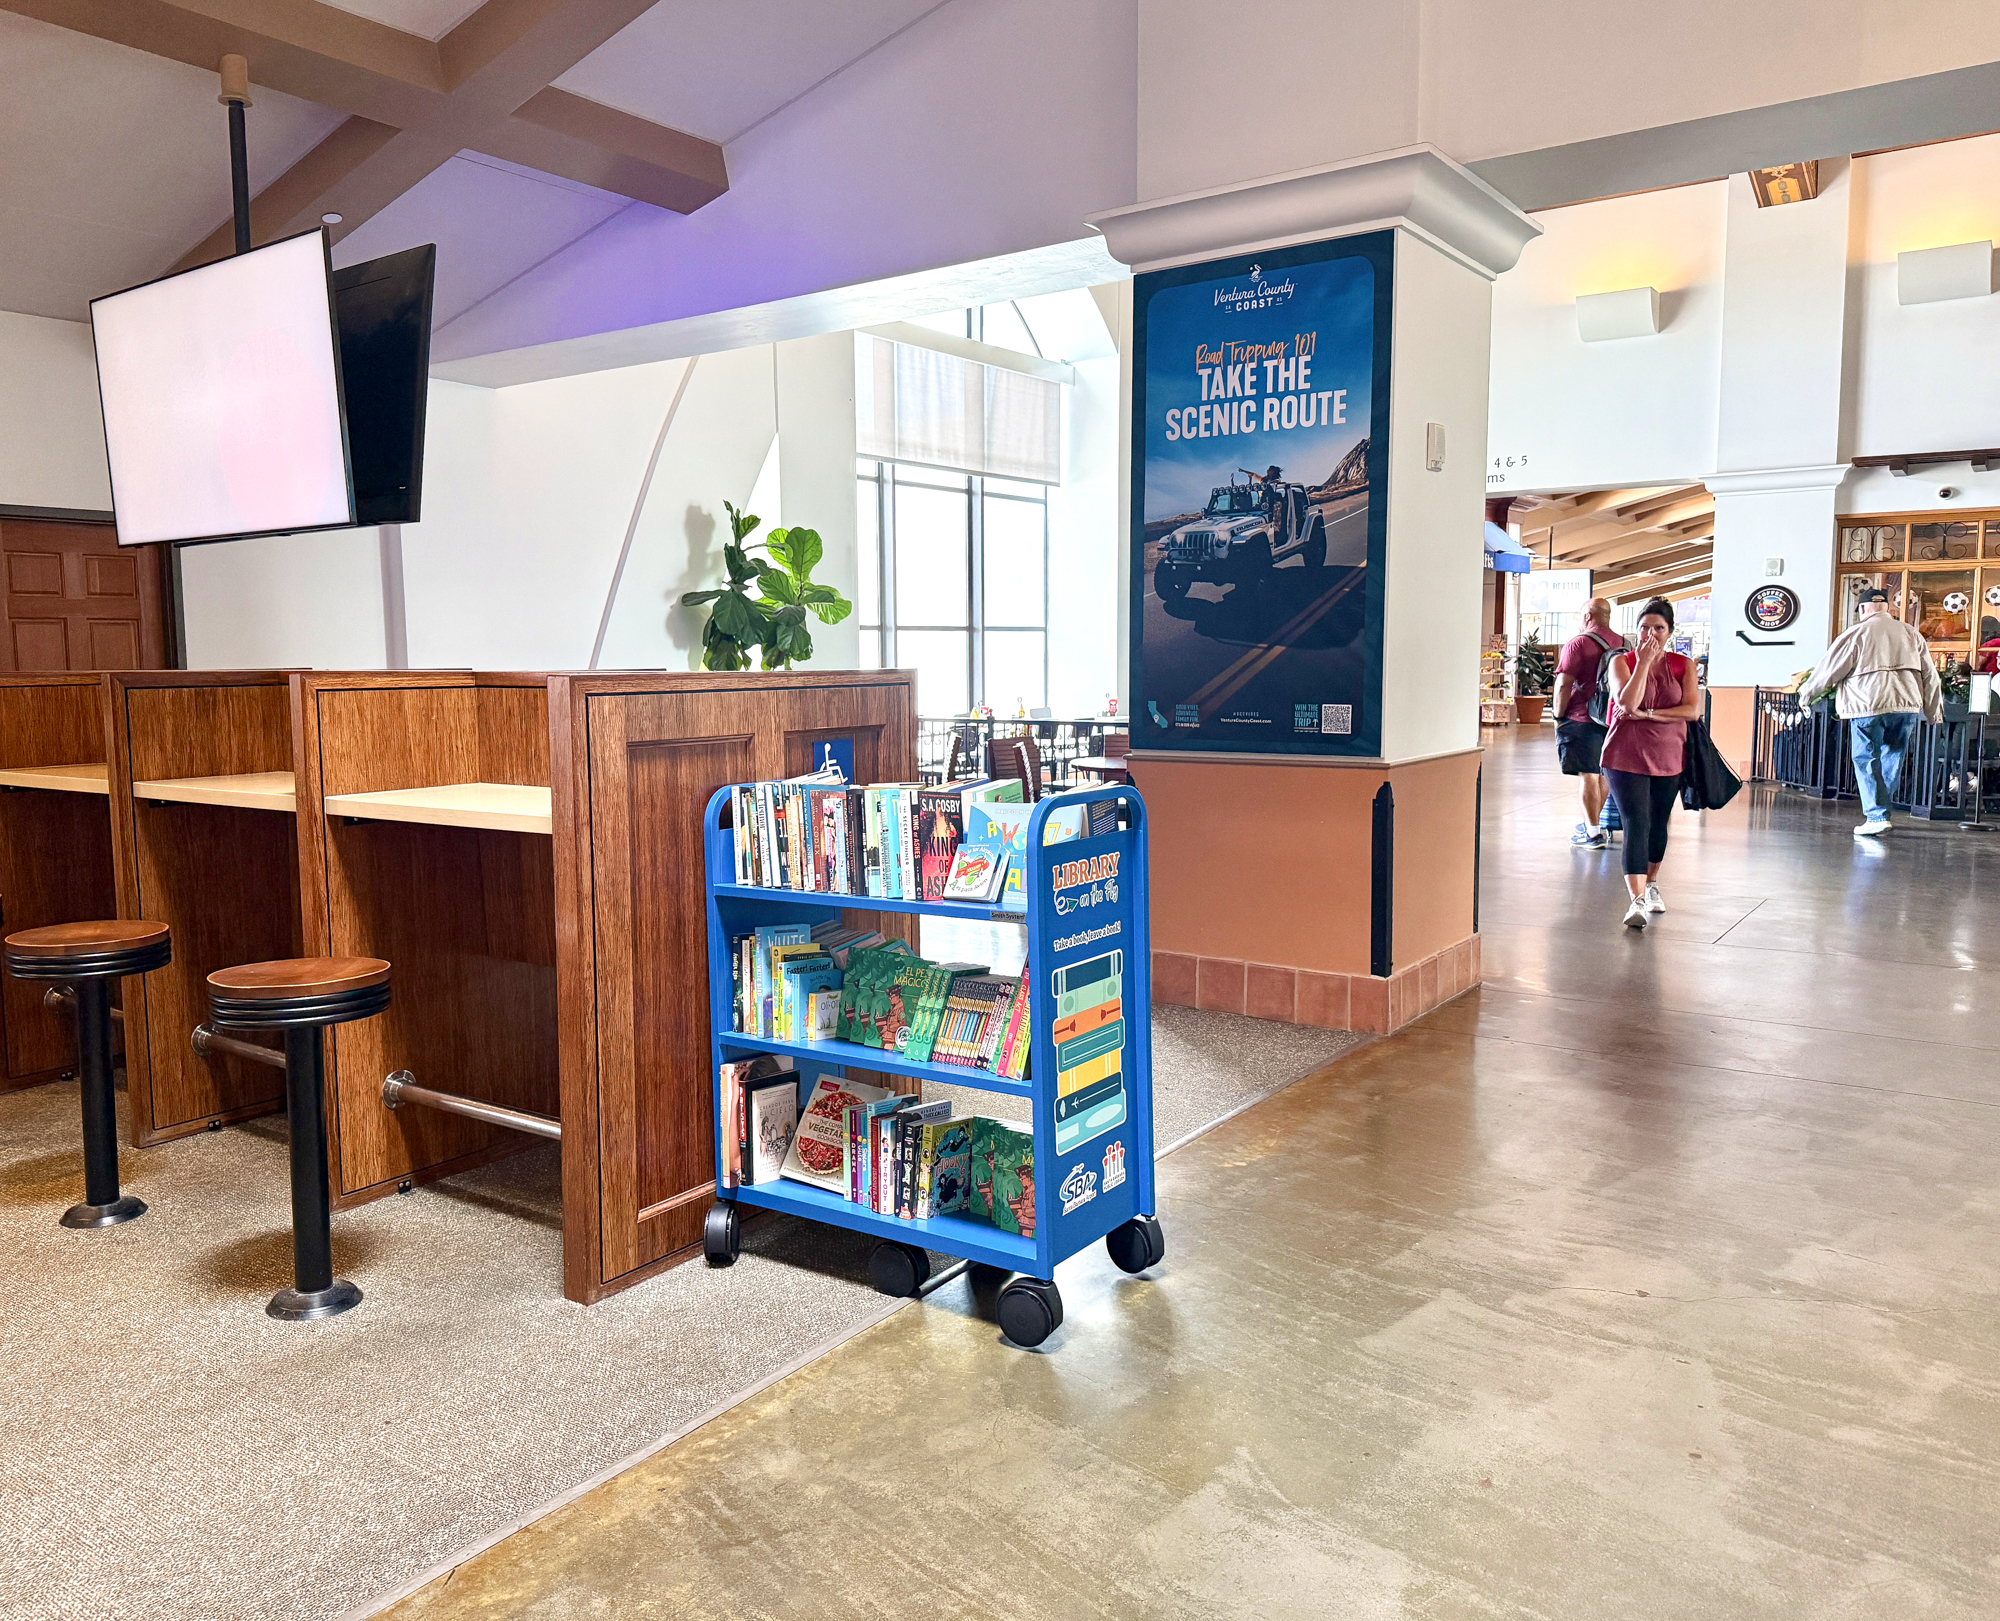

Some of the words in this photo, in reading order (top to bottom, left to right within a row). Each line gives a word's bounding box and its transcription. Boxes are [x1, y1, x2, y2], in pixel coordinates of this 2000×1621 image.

[1214, 285, 1256, 306] Ventura
[1257, 277, 1296, 299] County
[1236, 298, 1273, 312] COAST
[1196, 342, 1224, 373] Road
[1225, 340, 1290, 368] Tripping
[1294, 331, 1317, 357] 101
[1198, 363, 1257, 401] TAKE
[1263, 355, 1311, 394] THE
[1165, 399, 1256, 441] SCENIC
[1263, 389, 1347, 432] ROUTE
[1494, 457, 1501, 468] 4
[1506, 456, 1516, 468] &
[1521, 455, 1528, 467] 5
[1757, 590, 1785, 600] COFFEE
[1760, 619, 1781, 627] SHOP
[1307, 703, 1319, 711] THE
[1294, 718, 1311, 727] TRIP
[921, 799, 936, 812] S.A.
[936, 800, 960, 813] COSBY
[987, 820, 997, 838] A
[939, 860, 948, 873] OF
[1053, 851, 1120, 891] LIBRARY
[1080, 893, 1089, 907] on
[1090, 883, 1103, 907] the
[1104, 878, 1118, 903] Fly
[1005, 913, 1025, 921] System
[1053, 938, 1068, 952] Take
[1072, 931, 1088, 945] book,
[1088, 929, 1103, 943] leave
[1106, 920, 1121, 935] book!
[787, 964, 808, 975] Faster!
[809, 962, 830, 972] Faster!
[906, 967, 914, 976] EL
[916, 968, 927, 978] PE
[1017, 985, 1028, 1002] CLASS
[771, 1104, 794, 1116] CIELO
[808, 1122, 843, 1139] VEGETAR
[1067, 1173, 1092, 1203] SBA
